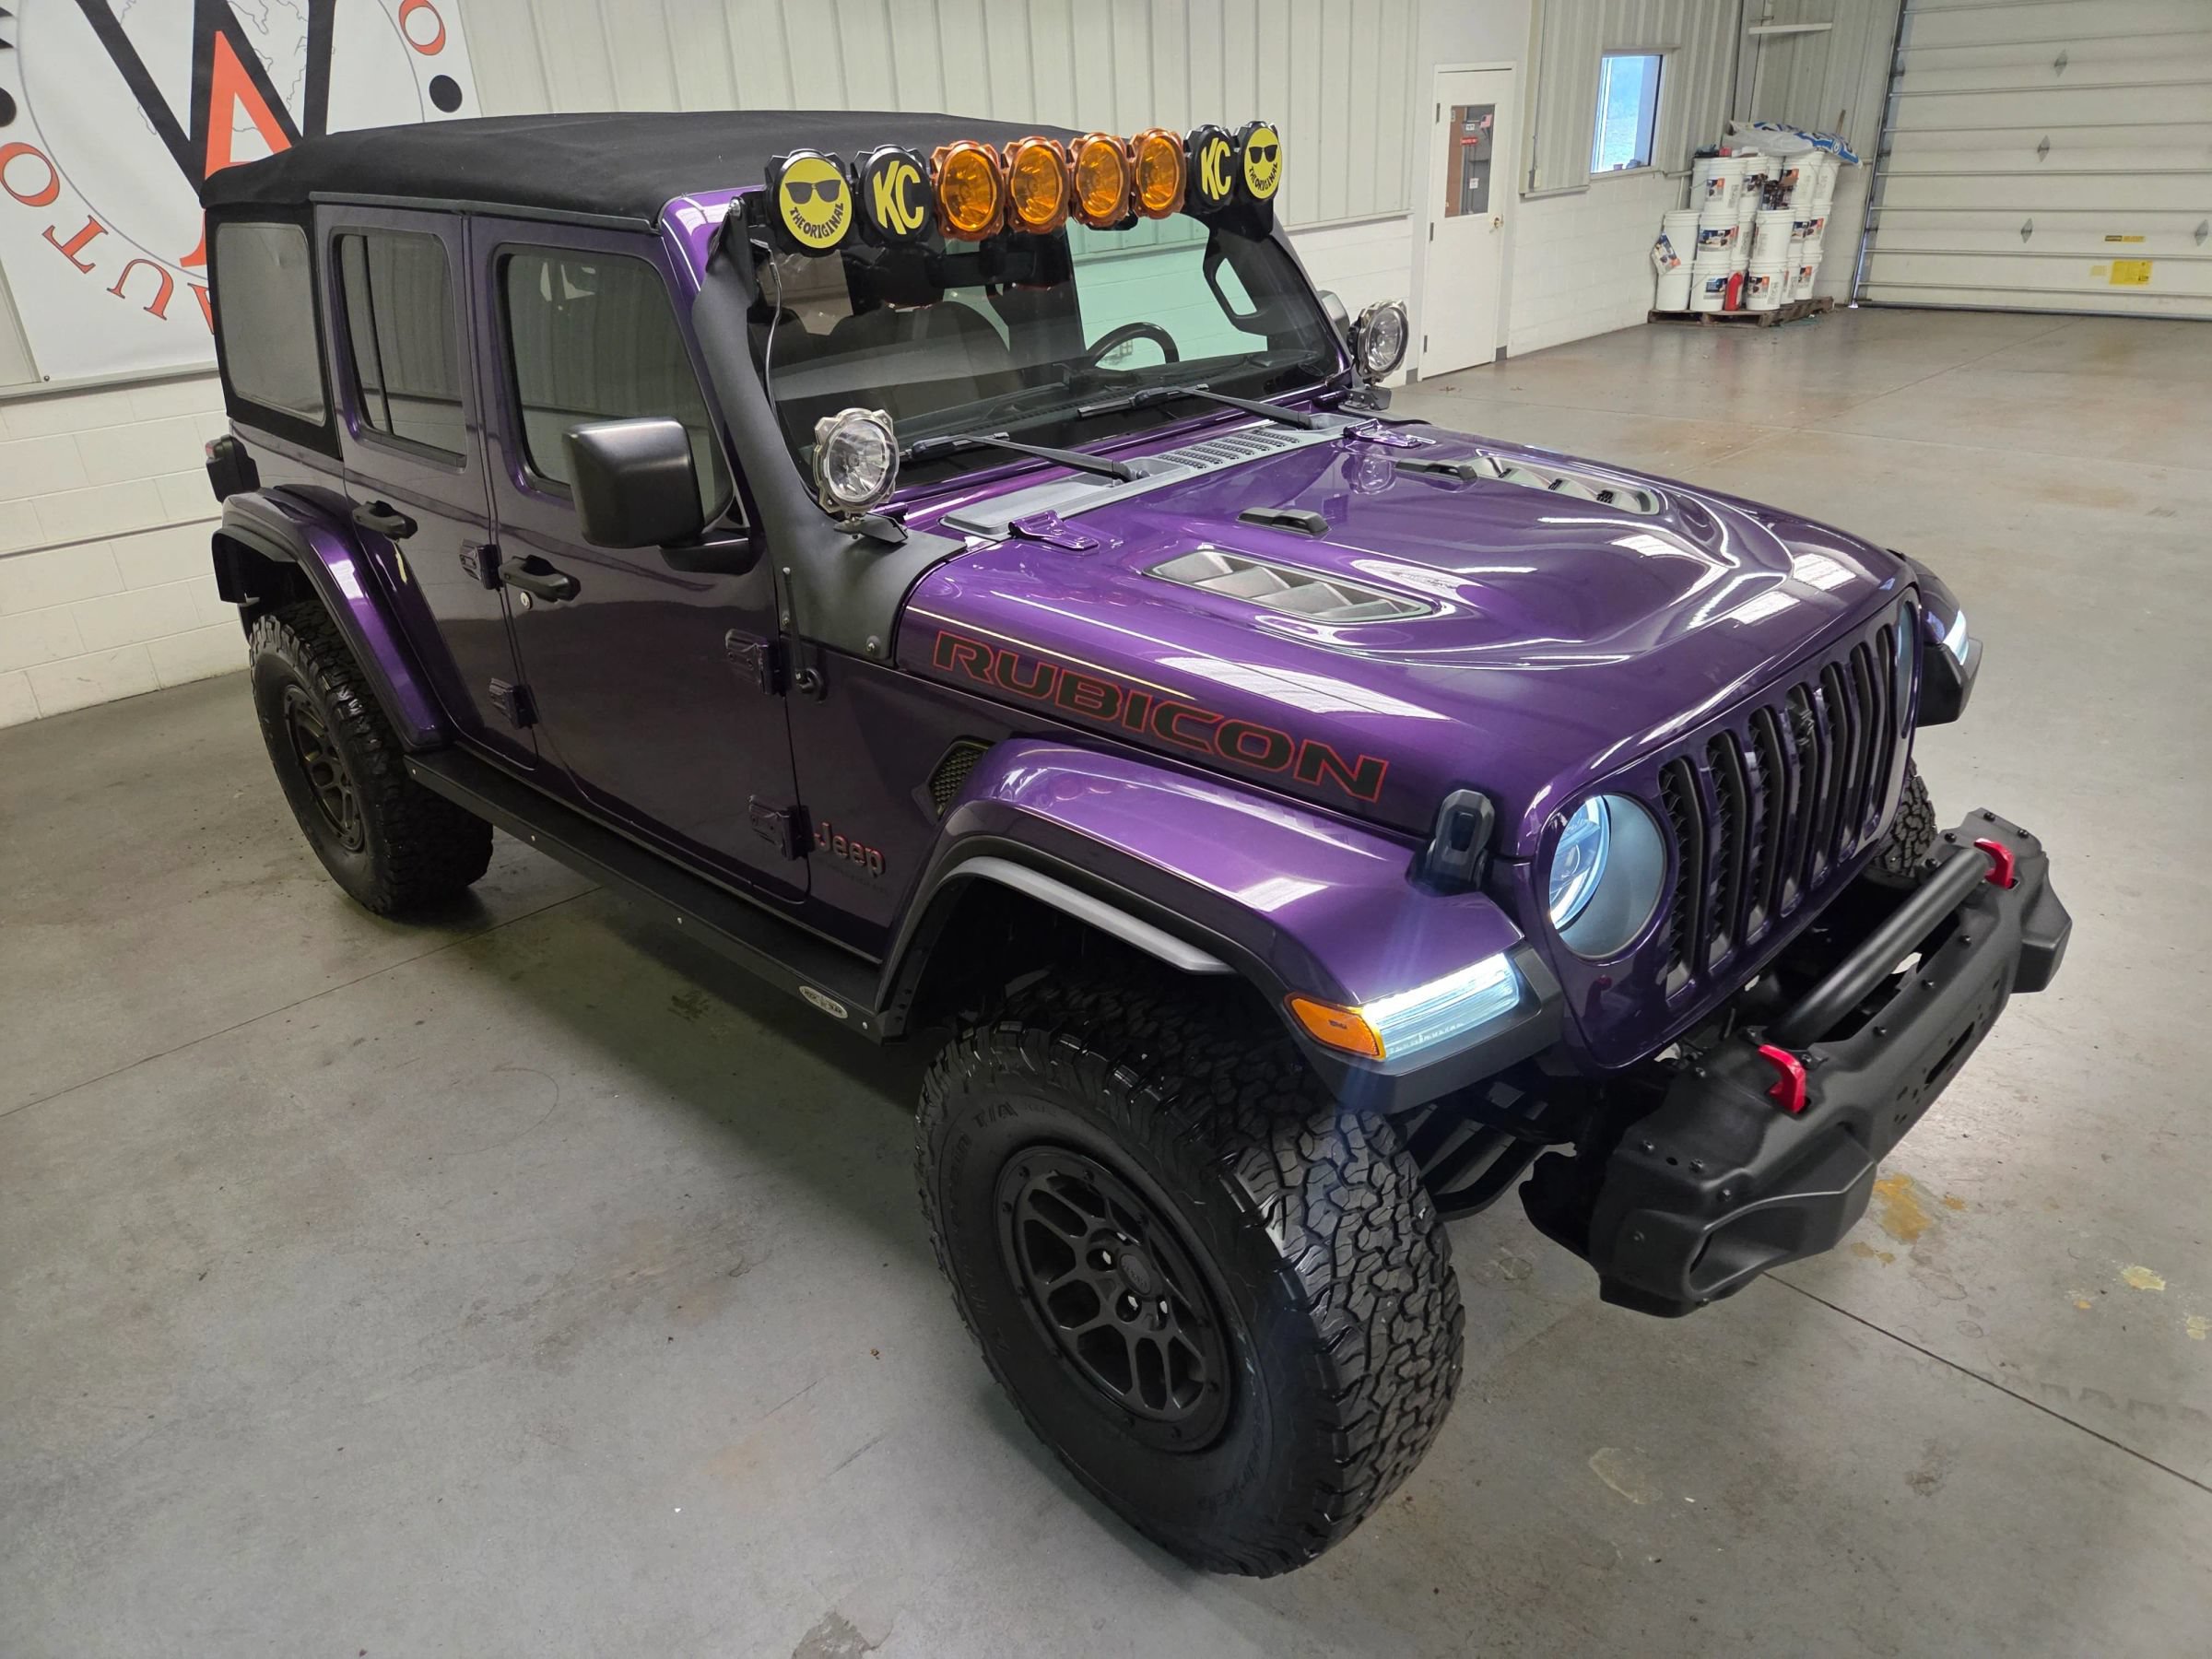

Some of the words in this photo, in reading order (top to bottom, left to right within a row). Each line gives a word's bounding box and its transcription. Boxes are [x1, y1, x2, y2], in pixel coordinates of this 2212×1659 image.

[872, 160, 924, 235] KC
[1200, 137, 1232, 201] KC
[790, 206, 806, 229] THE
[804, 203, 844, 239] ORIGINAL
[932, 629, 1390, 803] RUBICON
[813, 821, 886, 878] Jeep
